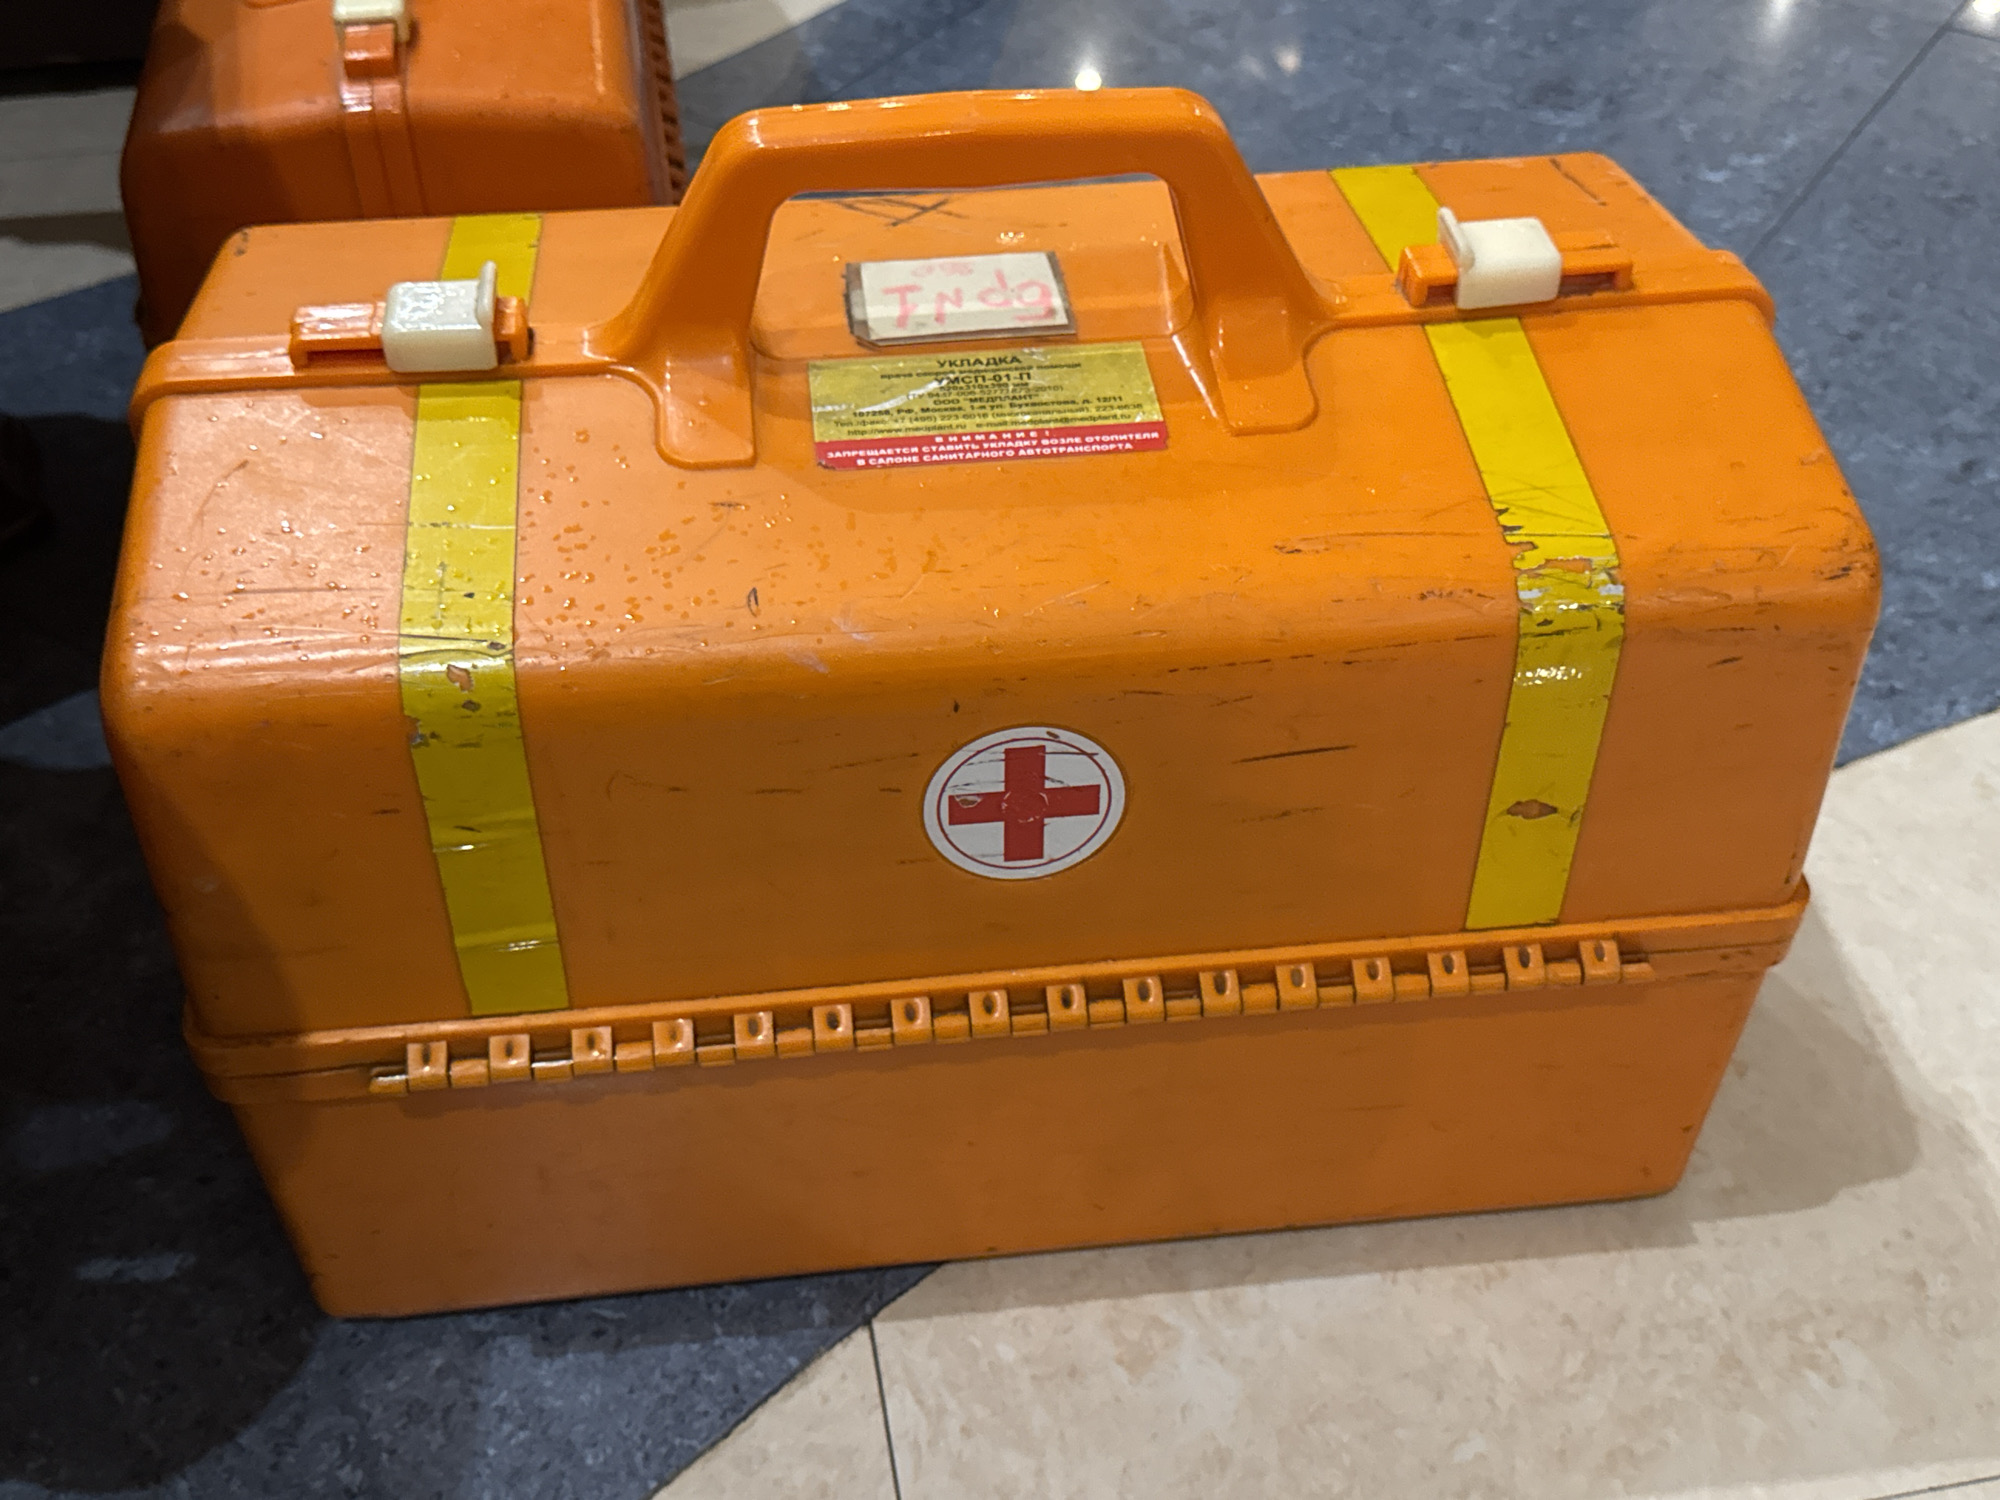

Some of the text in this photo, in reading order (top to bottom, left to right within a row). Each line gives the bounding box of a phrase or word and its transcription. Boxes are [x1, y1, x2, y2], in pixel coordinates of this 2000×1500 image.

[937, 356, 1022, 367] УКЛАДКА
[935, 373, 1031, 386] УМСП-01-П
[963, 393, 1039, 403] "МЕДПЛАНТ"
[827, 431, 1160, 458] ЗАПРЕЩАЕТСЯ СТАВИТЬ УКЛАДКУ ВОЗЛЕ ОТОПИТЕЛЯ
[856, 443, 1134, 466] В САЛОНЕ САНИТАРНОГО АВТОТРАНСПОРТА
